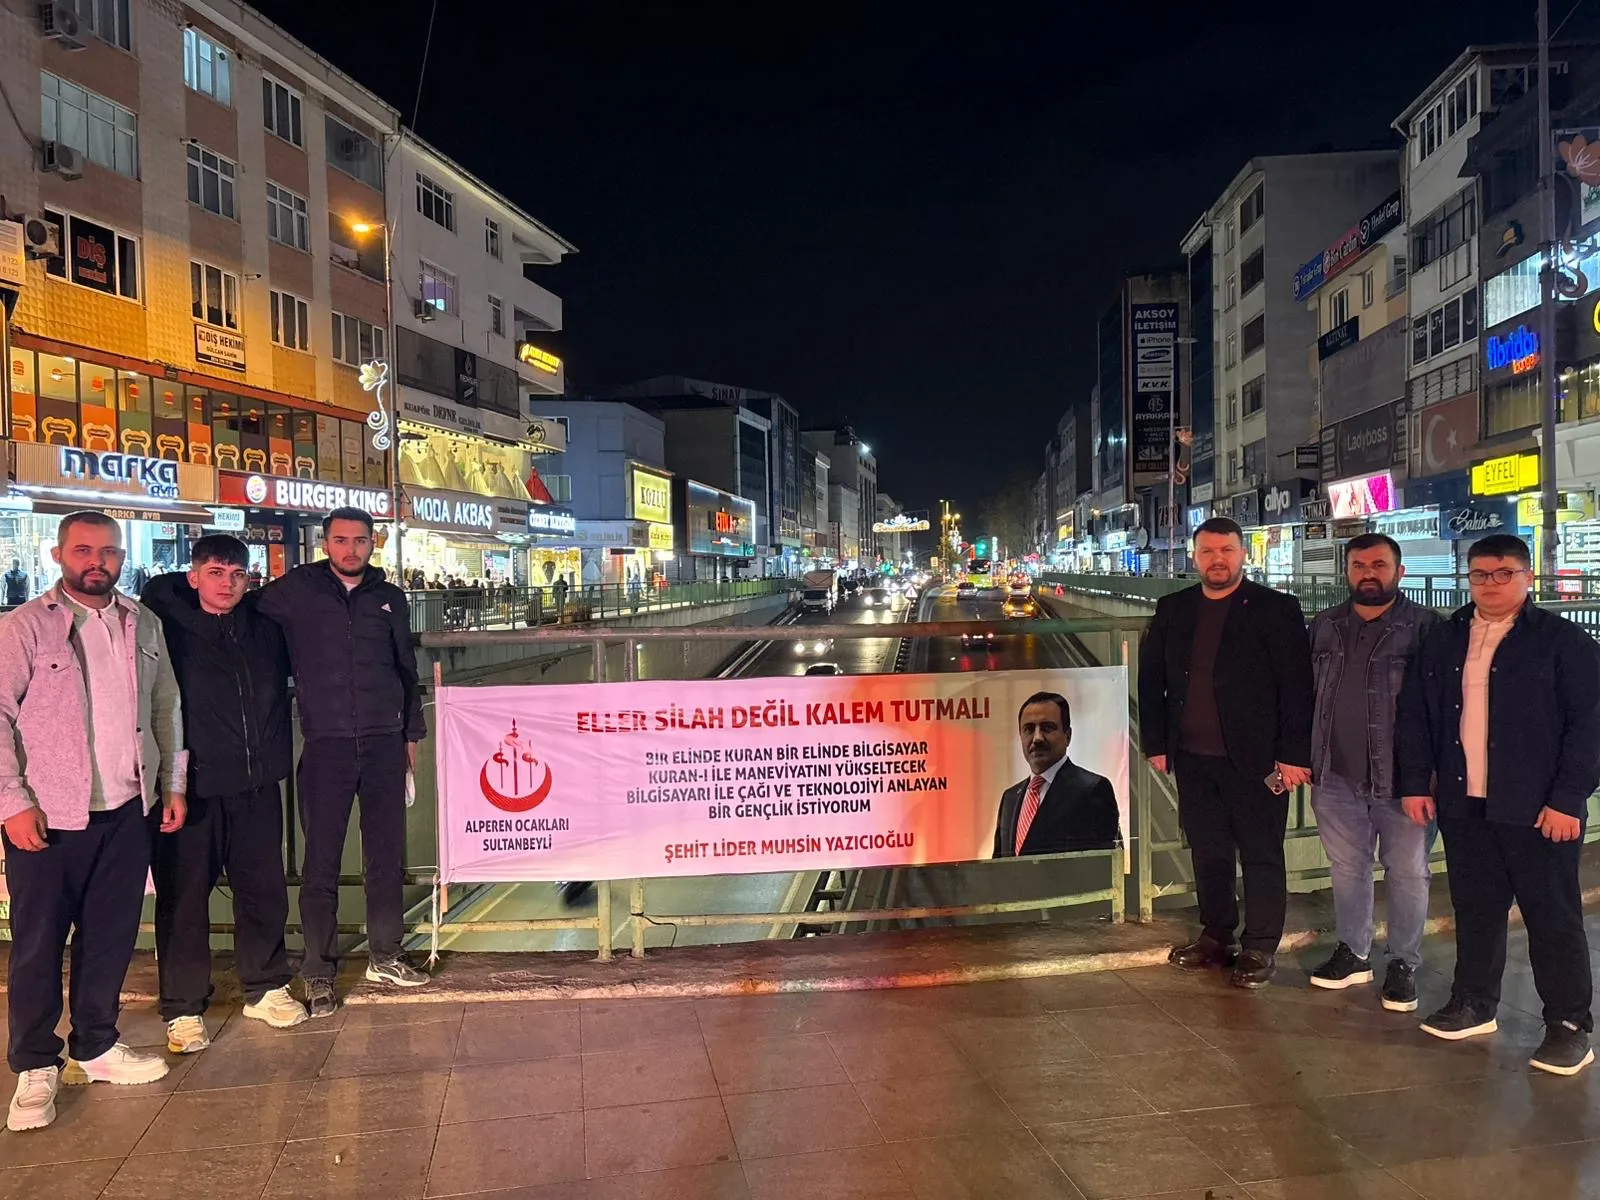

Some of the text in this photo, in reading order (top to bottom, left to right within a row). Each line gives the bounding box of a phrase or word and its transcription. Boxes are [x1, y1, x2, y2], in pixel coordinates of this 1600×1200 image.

[1135, 309, 1175, 319] AKSOY
[1134, 320, 1176, 331] İLETİŞİM
[205, 331, 217, 347] DİŞ
[433, 404, 457, 423] DEFNE
[1347, 426, 1388, 452] Ladyboss
[1485, 460, 1515, 482] EYFEL
[276, 479, 388, 514] BURGER KING
[640, 486, 667, 508] KOZLU
[413, 496, 493, 530] MODA AKBAŞ
[577, 696, 990, 734] ELLER SİLAH DEĞİL KALEM TUTMALI
[646, 740, 928, 766] BİR ELİNDE KURAN BİR ELİNDE BİLGİSAYAR
[711, 767, 732, 782] İLE
[735, 763, 831, 780] MANEVİYATINI
[836, 758, 927, 776] YÜKSELTECEK
[627, 777, 947, 804] BİLGİSAYARI İLE ÇAĞI VE TEKNOLOJİYİ ANLAYAN
[709, 798, 871, 820] BİR GENÇLİK İSTİYORUM
[465, 818, 569, 833] ALPEREN OCAKLARI
[483, 835, 552, 851] SULTANBEYLİ
[664, 830, 914, 863] ŞEHİT LİDER MUHSİN YAZICIOĞLU
